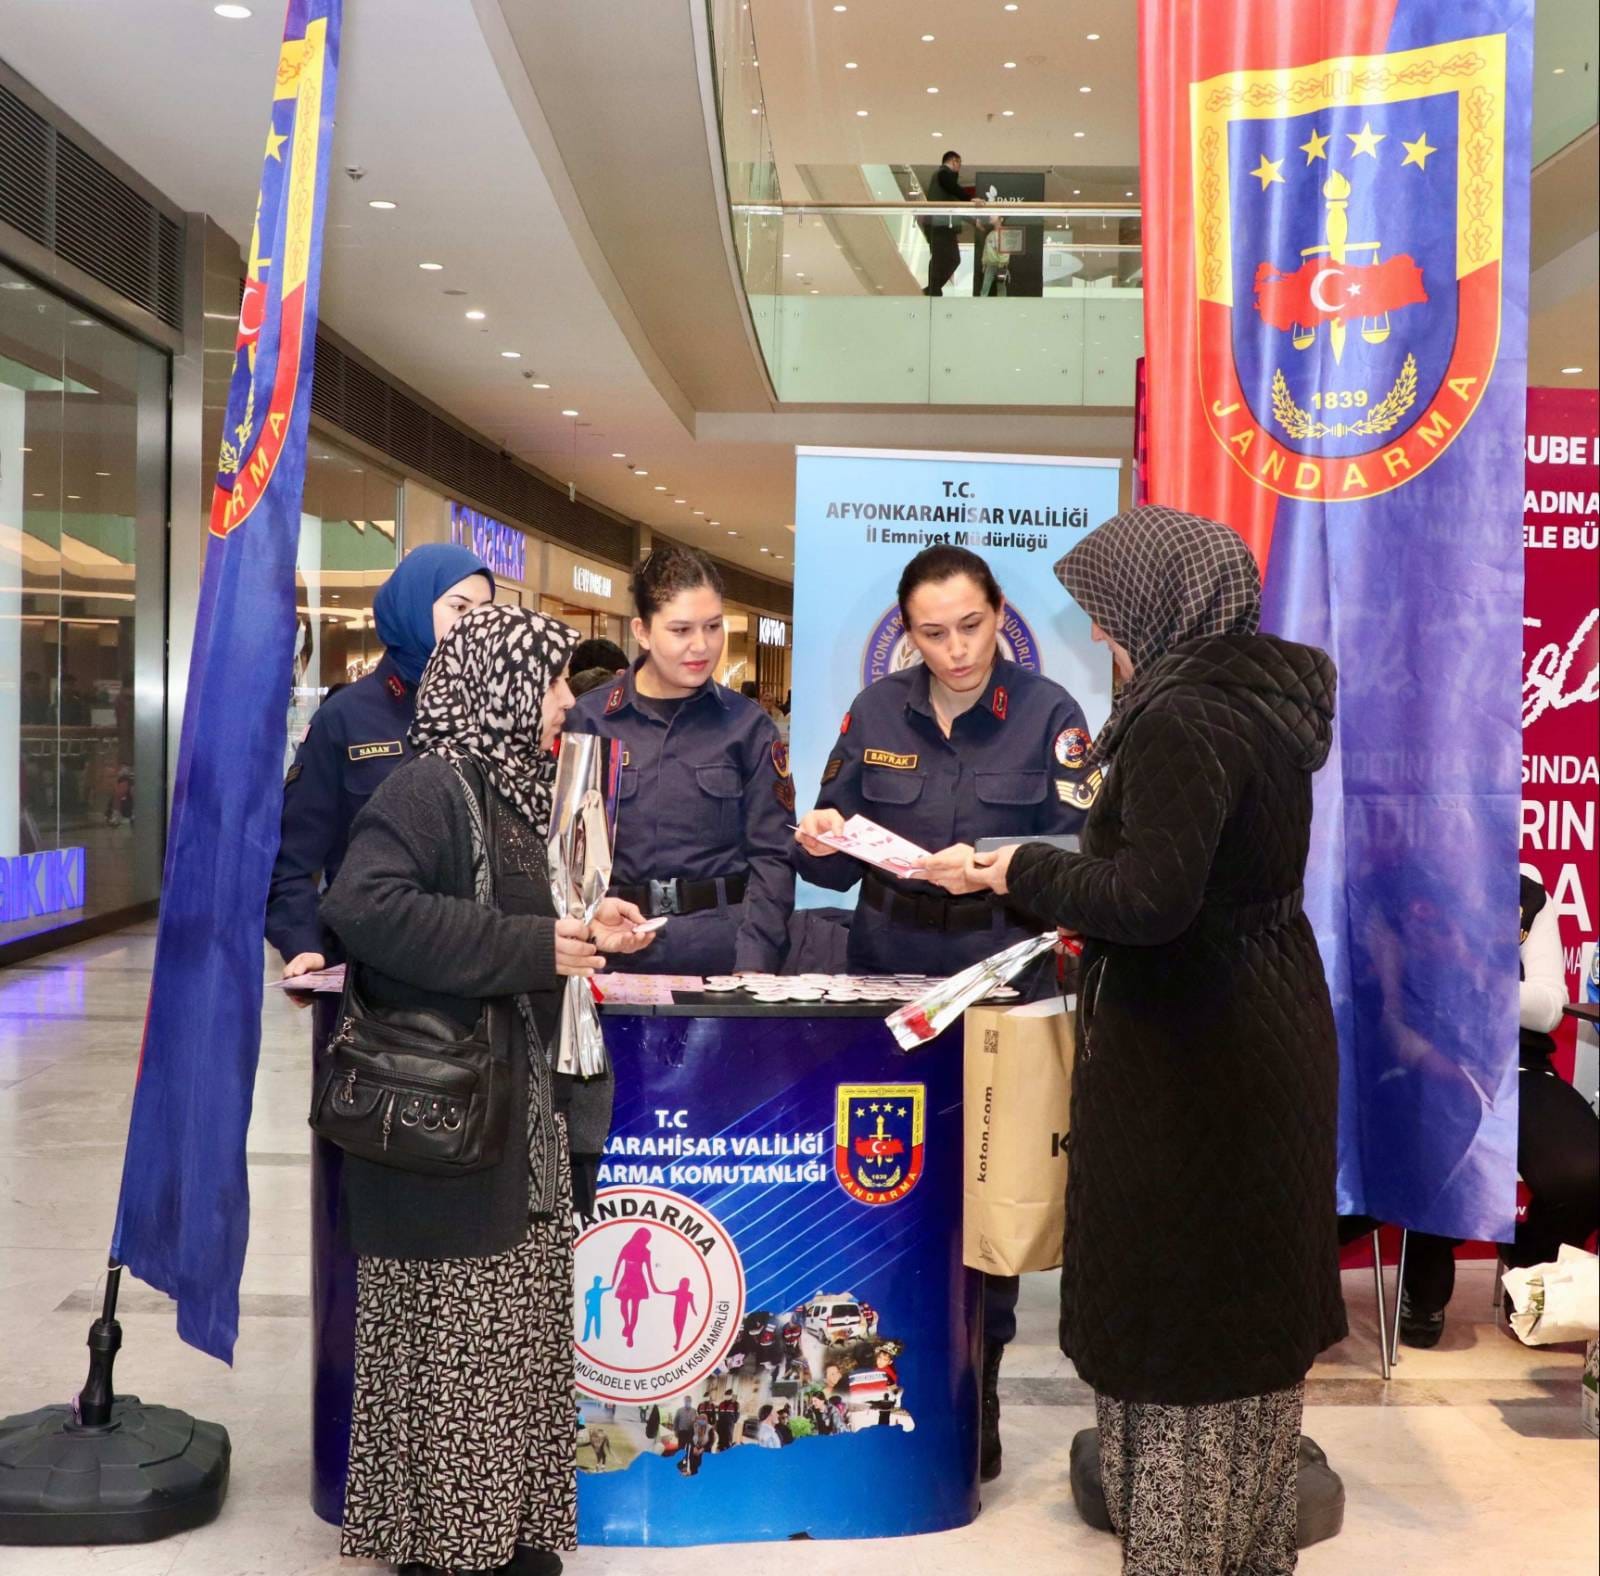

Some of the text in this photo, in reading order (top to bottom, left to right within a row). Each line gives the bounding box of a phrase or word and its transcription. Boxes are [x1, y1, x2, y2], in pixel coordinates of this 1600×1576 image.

[1311, 390, 1368, 410] 1839
[1212, 376, 1477, 492] JANDARMA
[1523, 435, 1587, 465] UBE
[942, 481, 975, 498] T.C.
[826, 501, 1088, 528] AFYONKARAHİSAR VALİLİĞİ
[867, 524, 1048, 552] İl Emniyet Müdürlüğü
[871, 752, 909, 766] BAYRAK
[655, 1109, 688, 1128] T.C
[731, 1132, 824, 1155] VALİLİĞİ
[977, 1086, 993, 1183] koton.com
[670, 1160, 826, 1184] KOMUTANLIĞI
[840, 1171, 918, 1202] JANDARMA
[634, 1379, 648, 1391] VE
[650, 1365, 688, 1391] ÇOCUK
[686, 1343, 713, 1371] KISIM
[706, 1300, 731, 1347] AMİRLİĞİ
